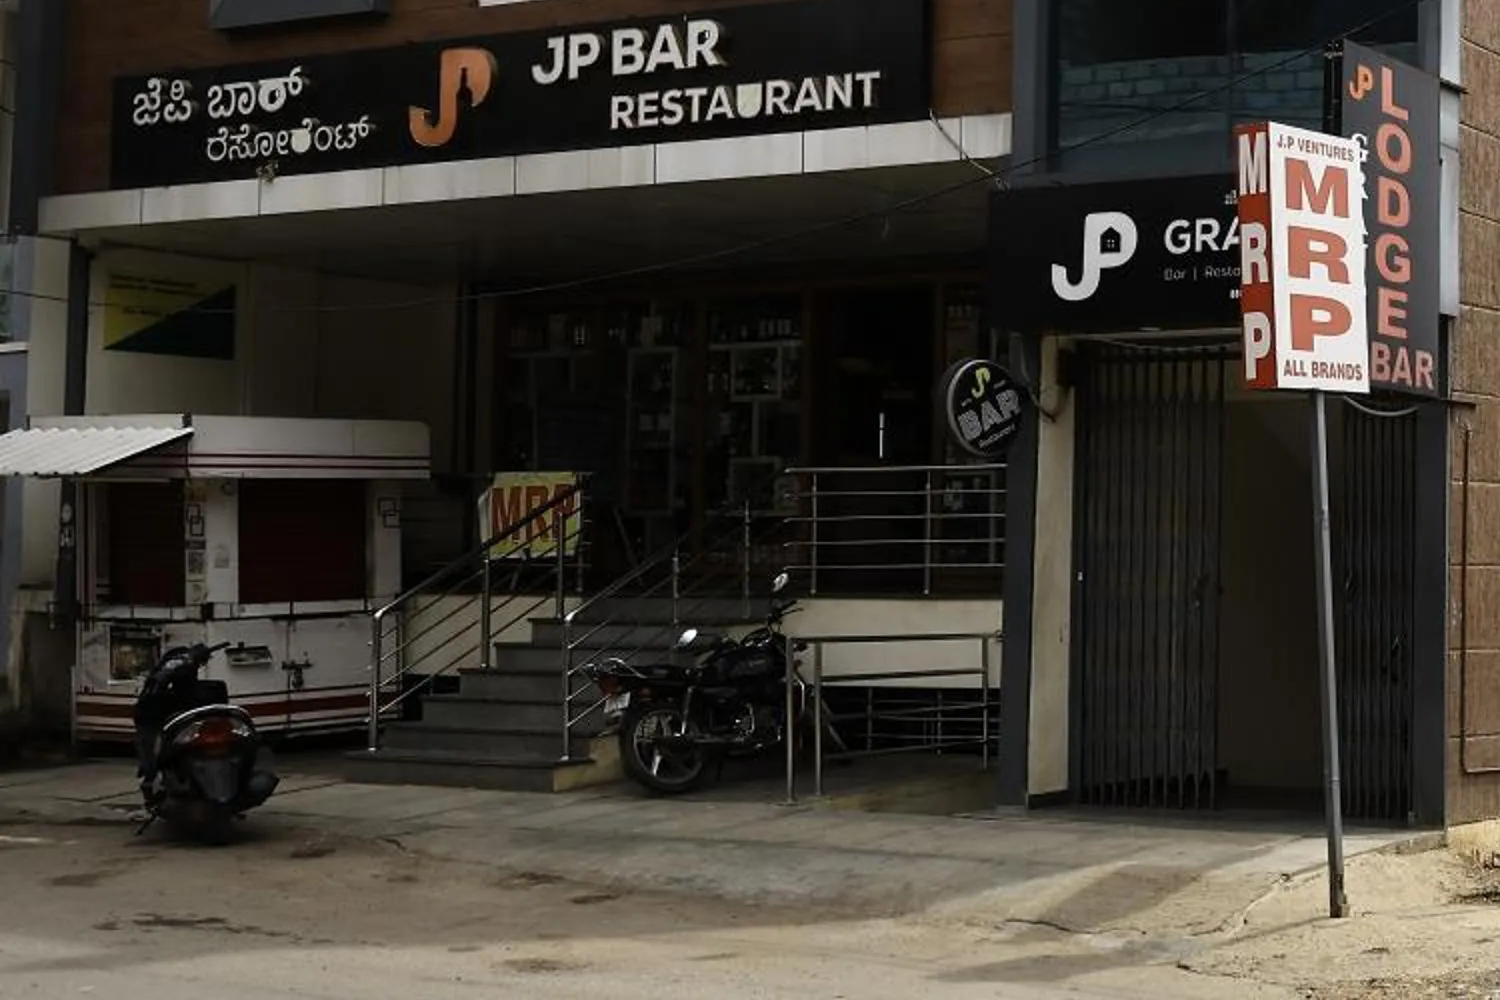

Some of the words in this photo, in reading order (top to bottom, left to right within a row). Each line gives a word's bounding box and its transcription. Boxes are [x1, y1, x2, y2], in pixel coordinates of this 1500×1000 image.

[532, 32, 600, 84] JP
[611, 19, 720, 76] BAR
[611, 71, 880, 130] RESTAURANT
[1298, 138, 1355, 163] VENTURES
[1375, 66, 1412, 340] LODGE
[1238, 131, 1271, 381] MRP
[1285, 157, 1353, 353] MRP
[1283, 359, 1307, 377] ALL
[1311, 361, 1363, 380] BRANDS
[1371, 341, 1435, 389] BAR
[957, 389, 1020, 441] BAR
